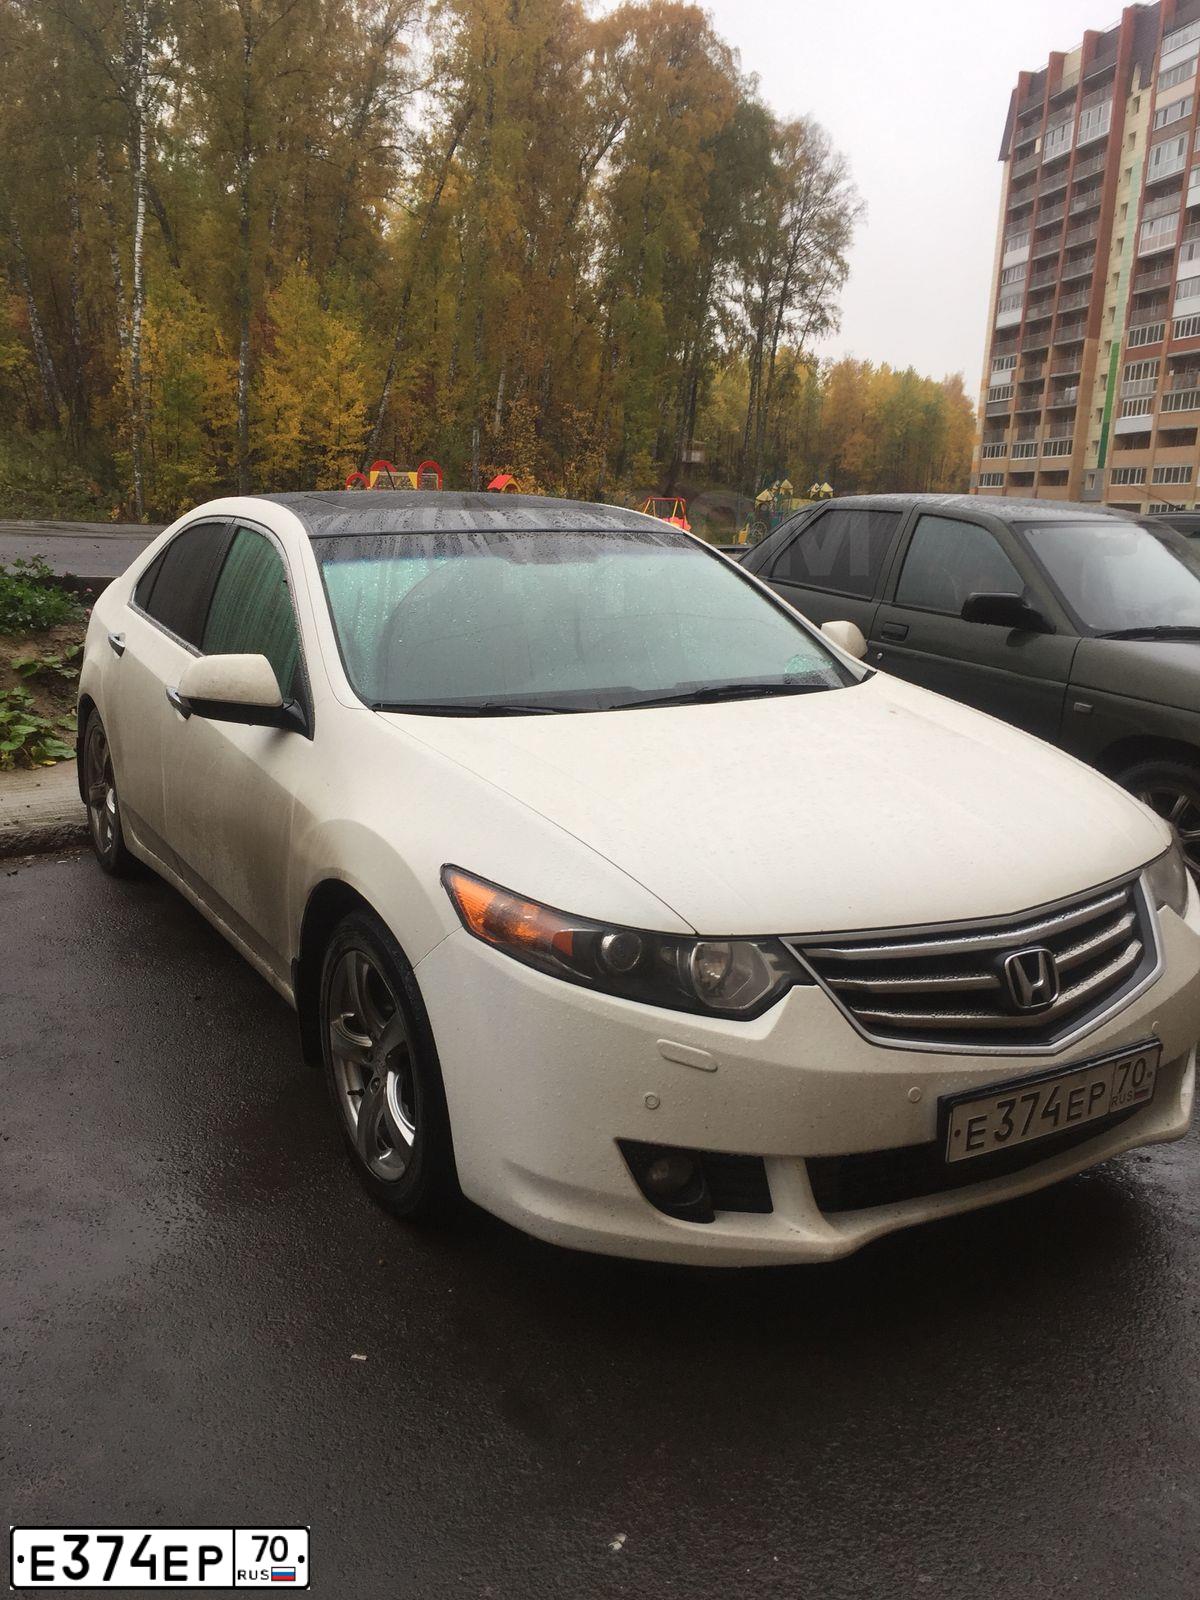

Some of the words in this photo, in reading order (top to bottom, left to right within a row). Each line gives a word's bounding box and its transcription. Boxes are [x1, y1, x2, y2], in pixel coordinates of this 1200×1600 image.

[965, 1082, 1106, 1152] E374EP
[1118, 1057, 1147, 1094] 70
[1111, 1089, 1134, 1107] RUS
